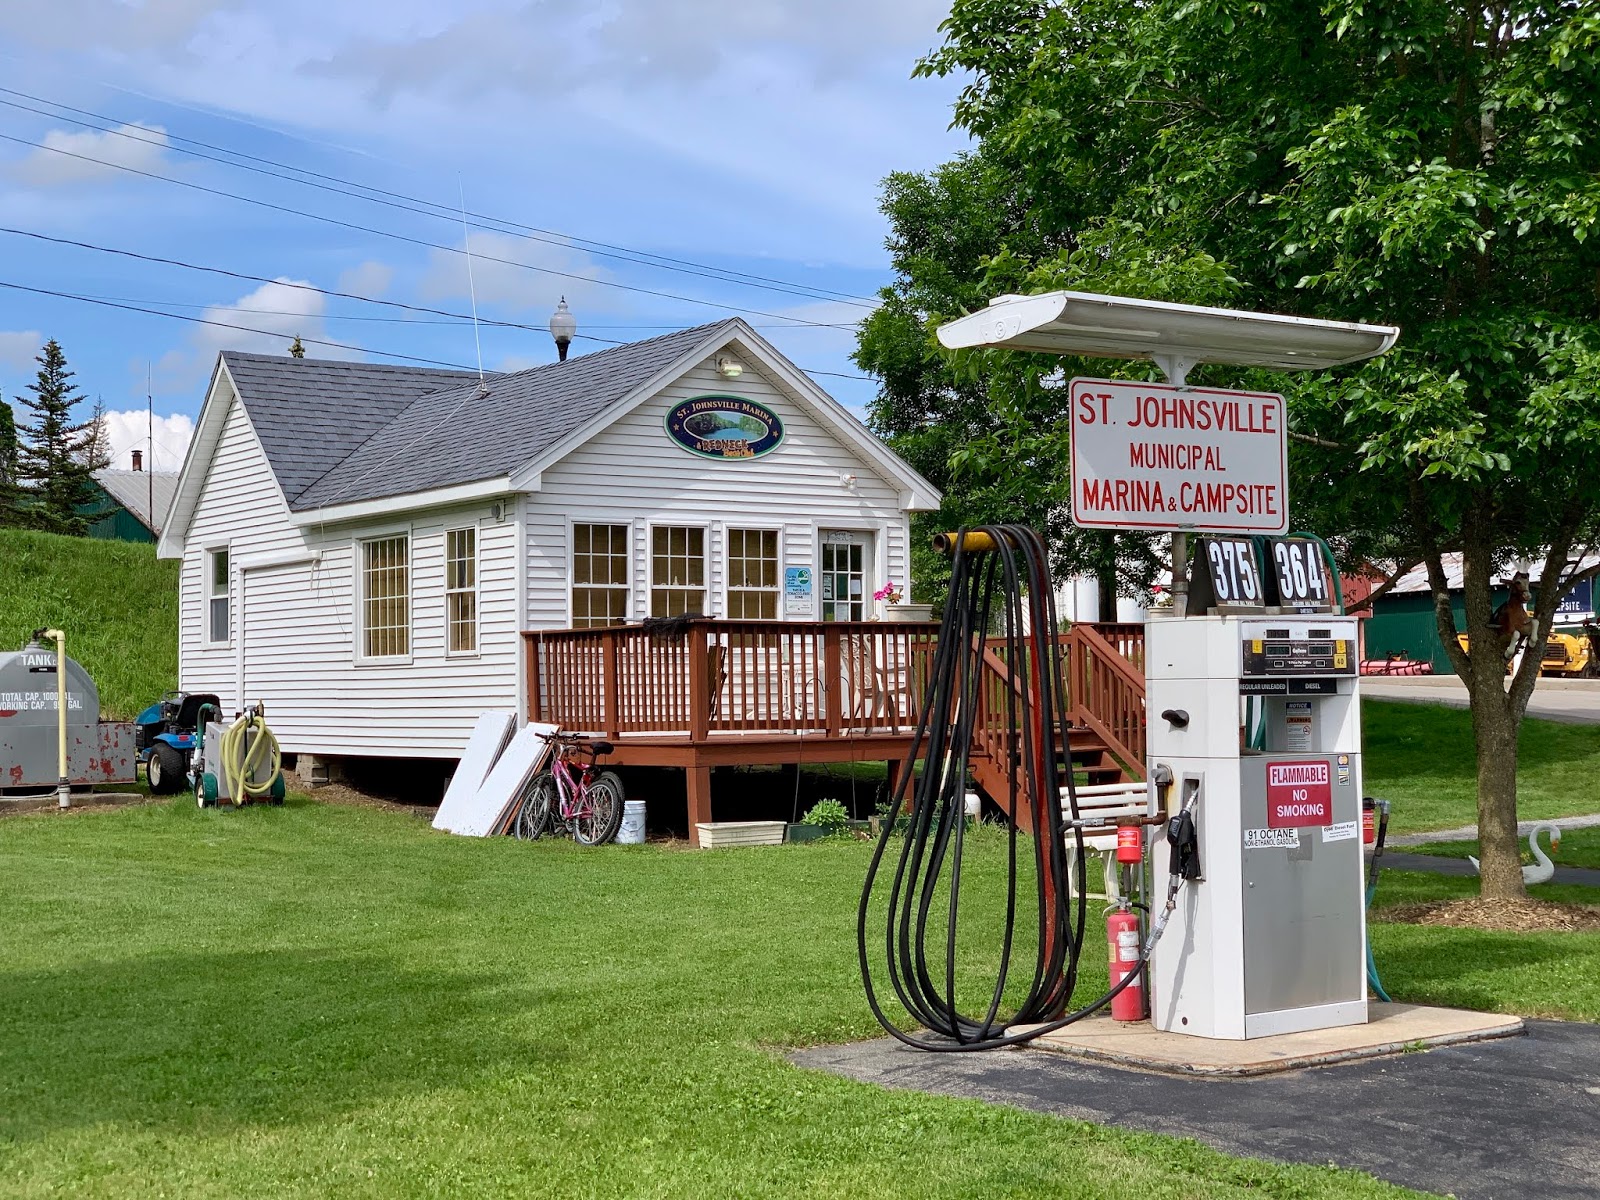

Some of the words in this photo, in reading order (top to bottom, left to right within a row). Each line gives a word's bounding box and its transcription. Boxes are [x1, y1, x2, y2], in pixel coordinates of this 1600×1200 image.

[691, 401, 740, 412] JOHNSVILLE
[742, 402, 773, 425] MARINA
[1079, 392, 1116, 425] ST.
[1127, 396, 1276, 434] JOHNSVILLE
[1130, 442, 1226, 472] MUNICIPAL
[1082, 478, 1165, 513] MARINA
[1168, 496, 1177, 512] &
[1180, 481, 1277, 515] CAMPSITE
[1209, 541, 1256, 600] 375
[1275, 542, 1322, 599] 364
[21, 654, 52, 666] TANK
[1, 692, 22, 702] TOTAL
[25, 692, 41, 701] CAP.
[31, 701, 47, 710] CAP.
[68, 700, 83, 709] GAL.
[1272, 766, 1326, 784] FLAMMABLE
[1292, 789, 1307, 801] NO
[1277, 803, 1324, 817] SMOKING
[1248, 830, 1257, 840] 91
[1260, 828, 1294, 839] OCTANE
[1276, 837, 1298, 846] GASOLINE
